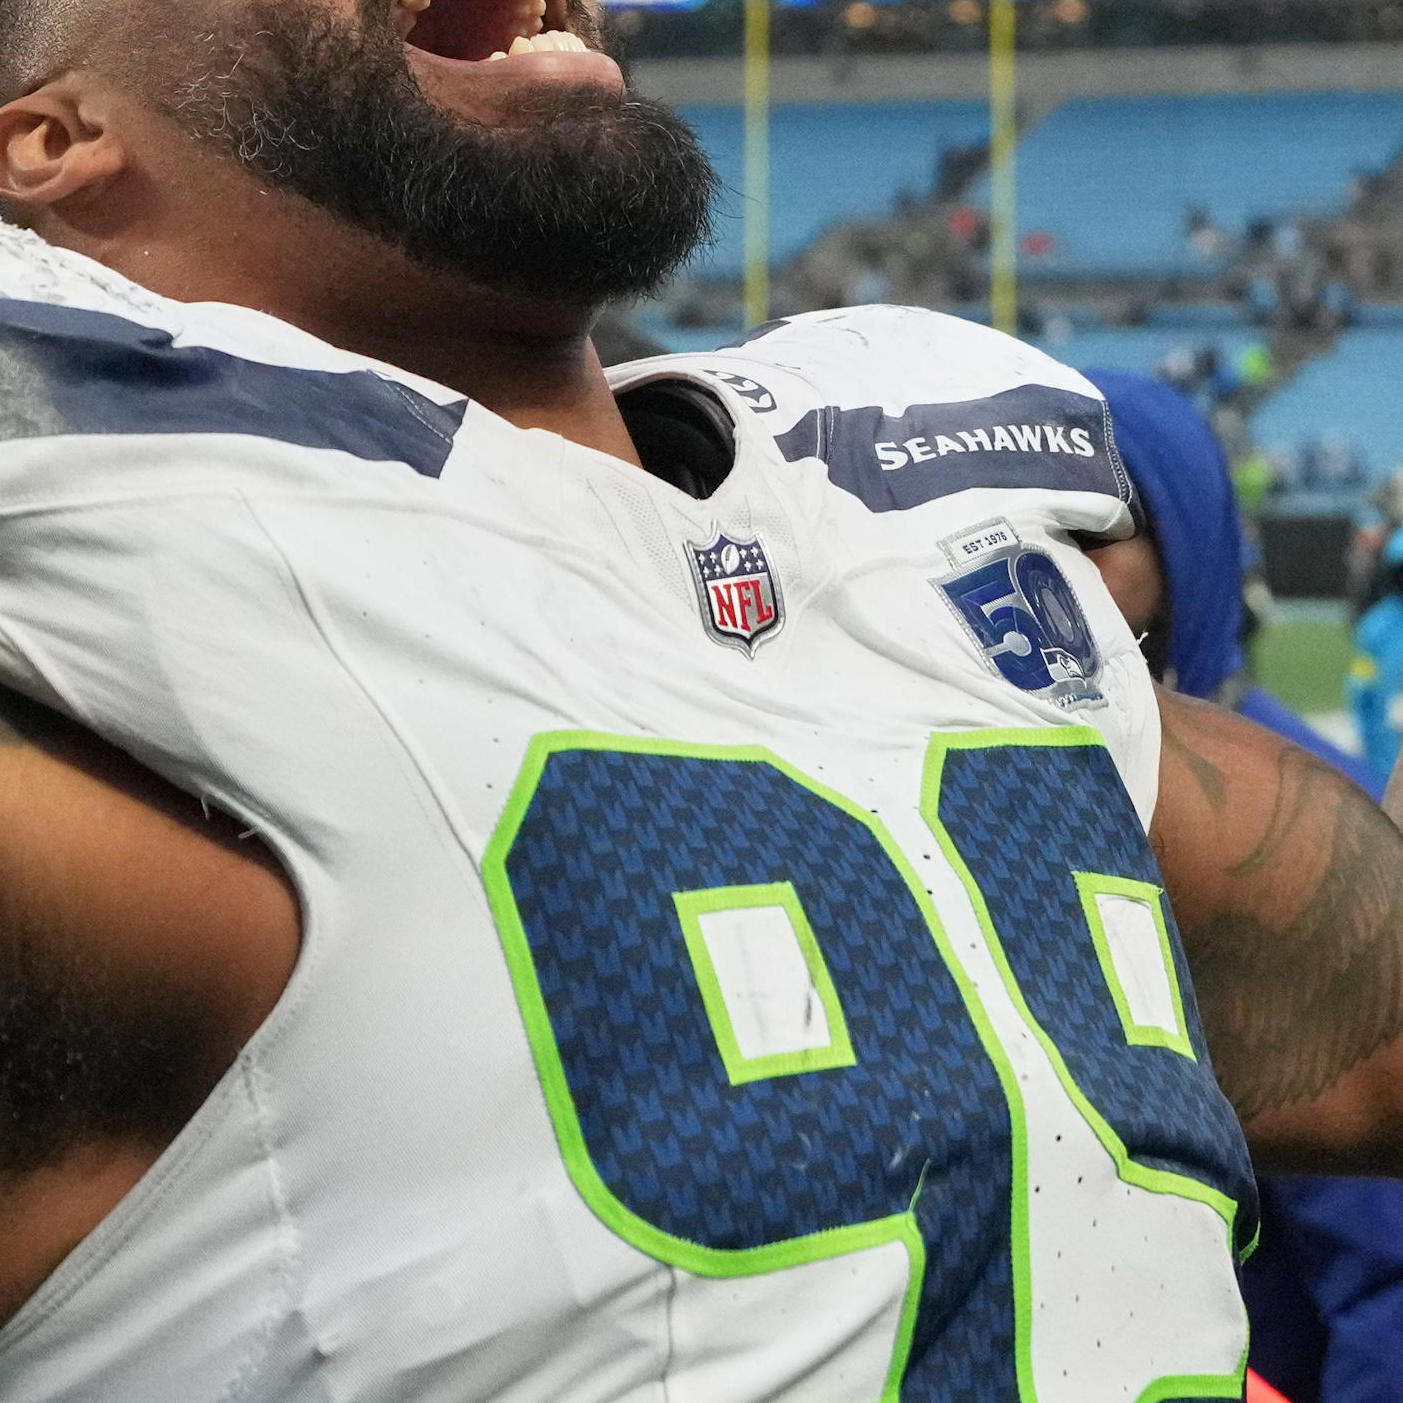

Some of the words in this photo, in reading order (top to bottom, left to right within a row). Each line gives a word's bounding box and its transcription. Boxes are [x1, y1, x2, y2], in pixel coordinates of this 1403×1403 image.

[874, 425, 1095, 471] SEAHAWKS
[962, 538, 985, 555] EST
[986, 531, 1008, 547] 1976
[711, 579, 773, 632] NFL
[941, 551, 1099, 691] 50
[481, 726, 1261, 1403] 99
